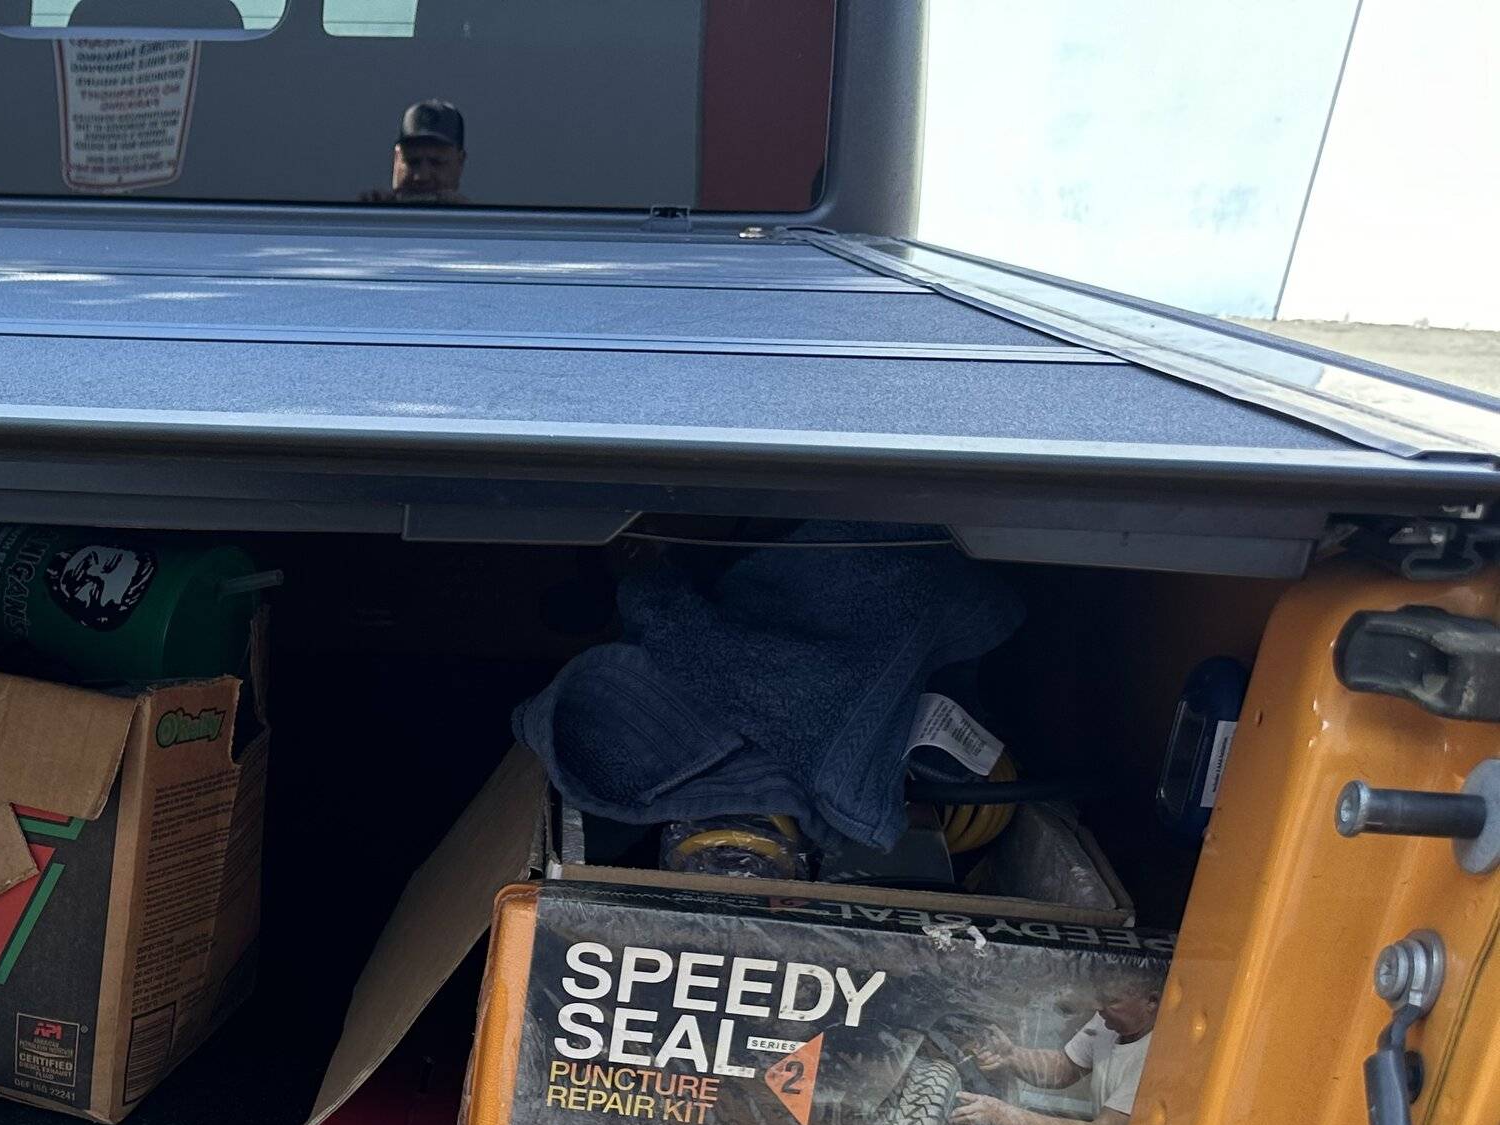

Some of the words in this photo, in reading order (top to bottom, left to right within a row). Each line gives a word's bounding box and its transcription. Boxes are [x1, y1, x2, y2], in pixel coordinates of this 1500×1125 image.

[987, 918, 1175, 952] PEEDY
[562, 941, 886, 1027] SPEEDY
[554, 1003, 756, 1079] SEAL
[751, 1039, 796, 1051] SERIES
[19, 1052, 73, 1070] CERTIFIED
[549, 1060, 720, 1101] PUNCTURE
[780, 1060, 806, 1095] 2
[546, 1085, 655, 1119] REPAIR
[663, 1098, 714, 1124] KIT
